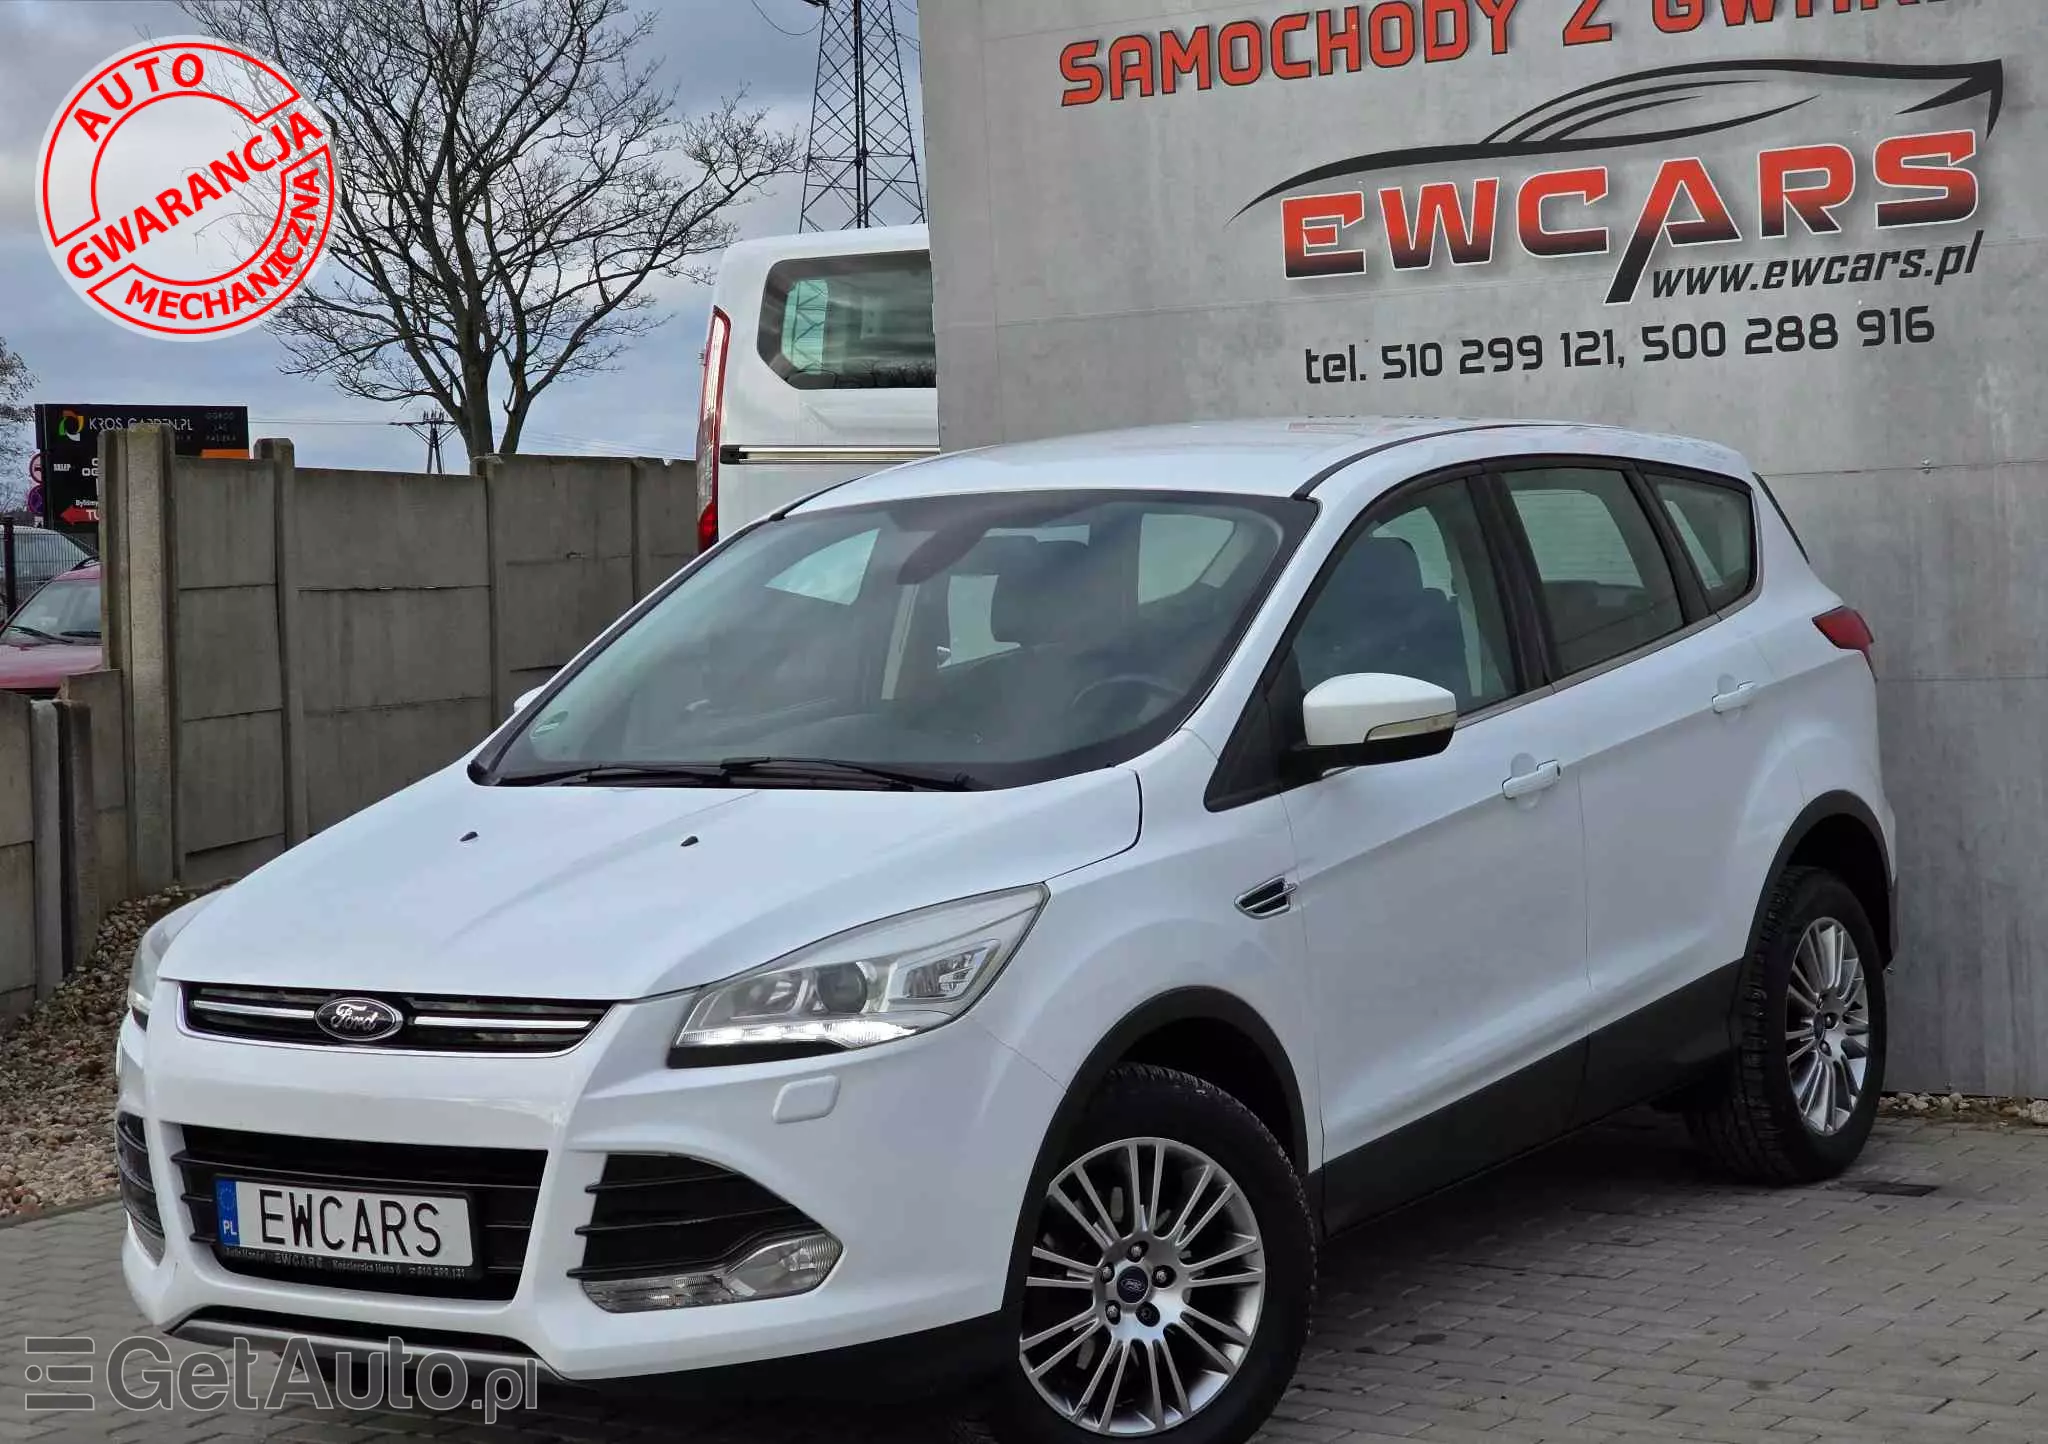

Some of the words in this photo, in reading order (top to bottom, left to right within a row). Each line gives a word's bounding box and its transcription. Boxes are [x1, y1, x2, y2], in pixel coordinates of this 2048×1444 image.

[1059, 0, 1517, 106] SAMOCHODY
[1562, 0, 1613, 46] Z
[1281, 129, 1979, 304] EWCARS
[1652, 229, 1984, 298] www.ewcars.pl
[1305, 344, 1366, 384] tel.
[1381, 342, 1443, 380] 510
[1459, 335, 1543, 374] 299
[1560, 329, 1625, 368] 121,
[1641, 321, 1726, 362] 500
[1744, 313, 1838, 354] 288
[1856, 305, 1935, 347] 916
[330, 1003, 379, 1032] Ford
[223, 1219, 238, 1237] PL
[259, 1188, 442, 1258] EWCARS
